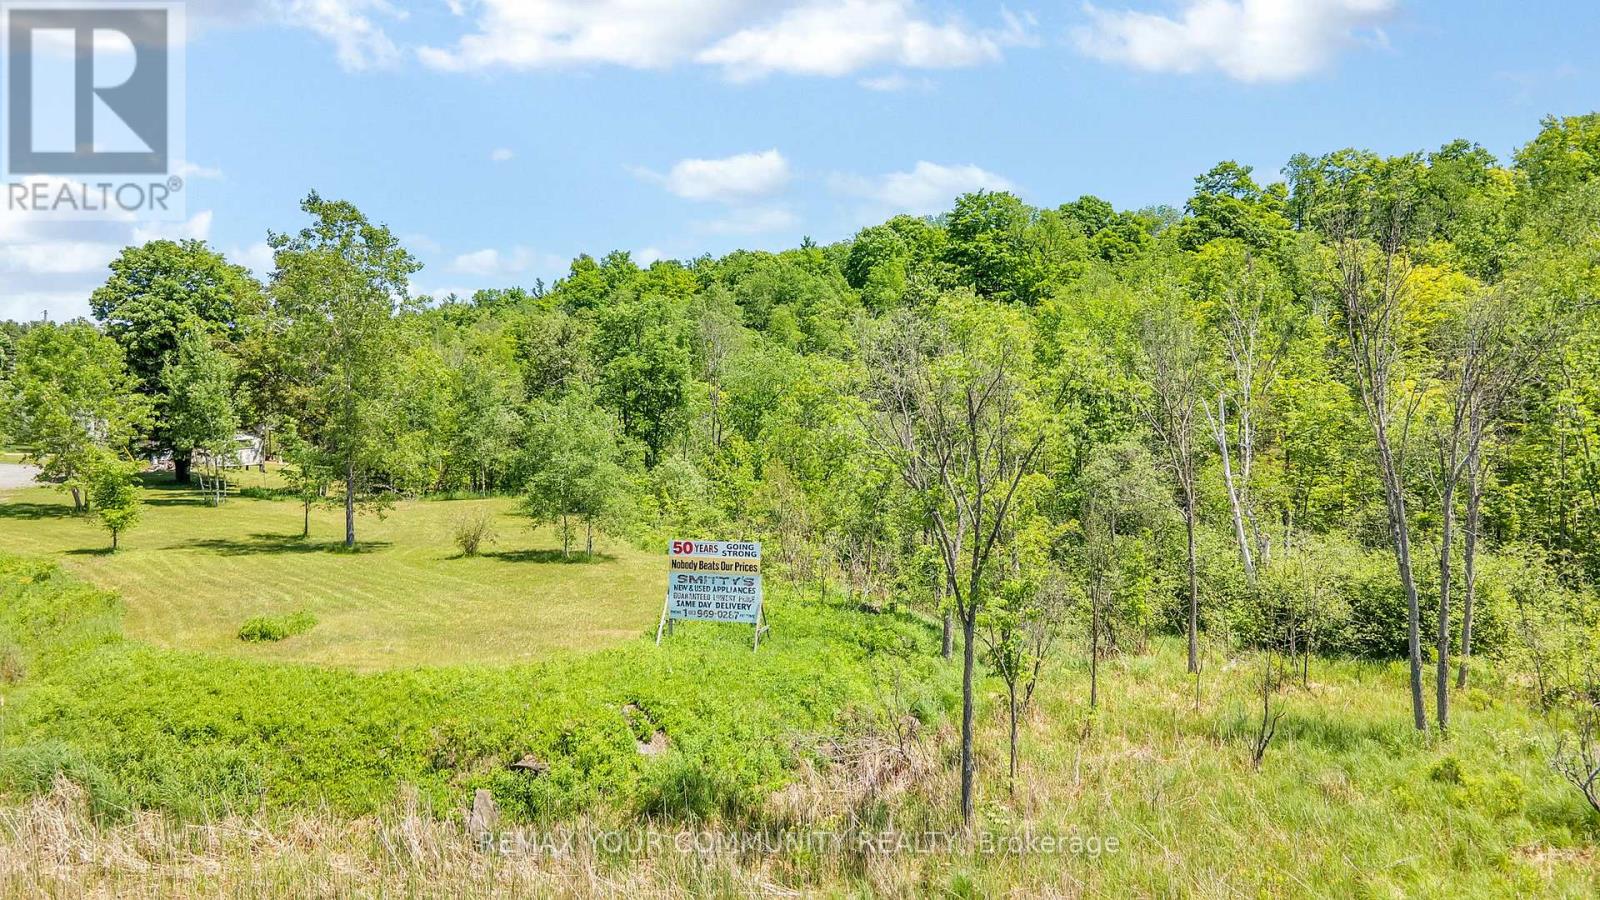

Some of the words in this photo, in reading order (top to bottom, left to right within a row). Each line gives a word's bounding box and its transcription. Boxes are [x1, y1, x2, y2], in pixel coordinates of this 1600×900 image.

[673, 542, 693, 554] 50
[694, 544, 718, 553] YEARS
[672, 560, 698, 570] Nobody
[699, 561, 719, 570] Beats
[721, 562, 733, 570] Our
[735, 562, 757, 572] Prices
[713, 586, 756, 594] APPLIANCES
